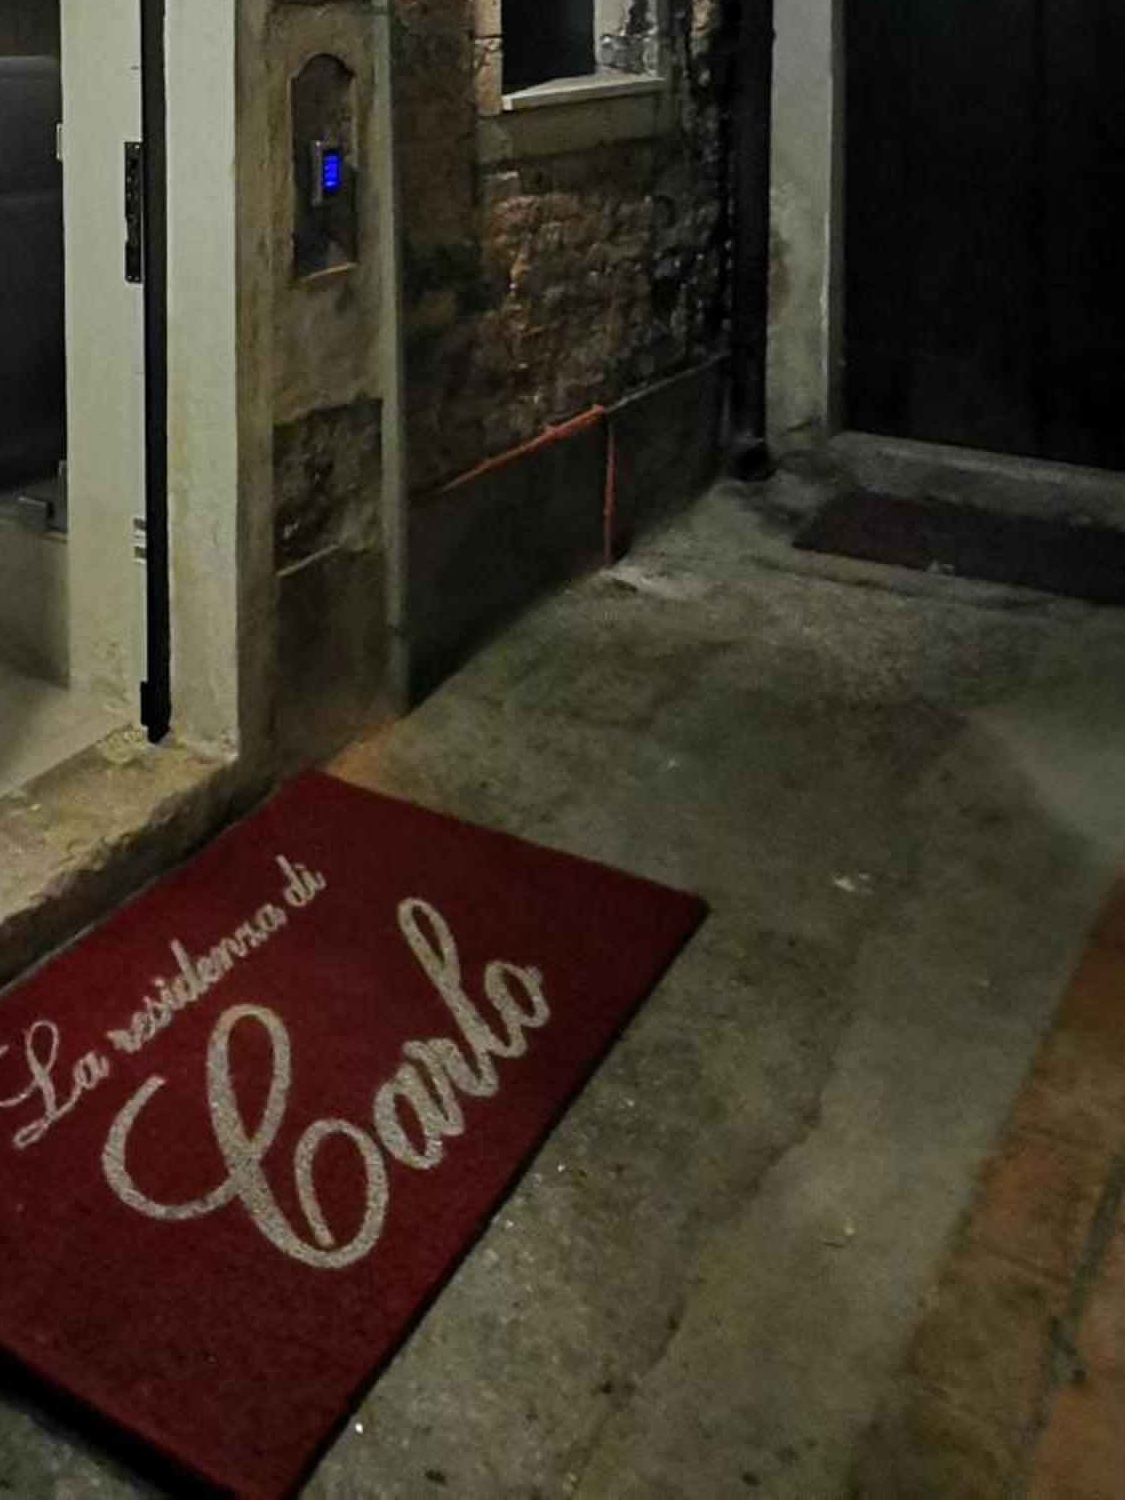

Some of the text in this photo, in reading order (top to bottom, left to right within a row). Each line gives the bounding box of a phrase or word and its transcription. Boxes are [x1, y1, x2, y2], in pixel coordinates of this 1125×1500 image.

[101, 898, 551, 1269] Carlo
[106, 903, 288, 1053] residenza
[276, 854, 326, 907] di
